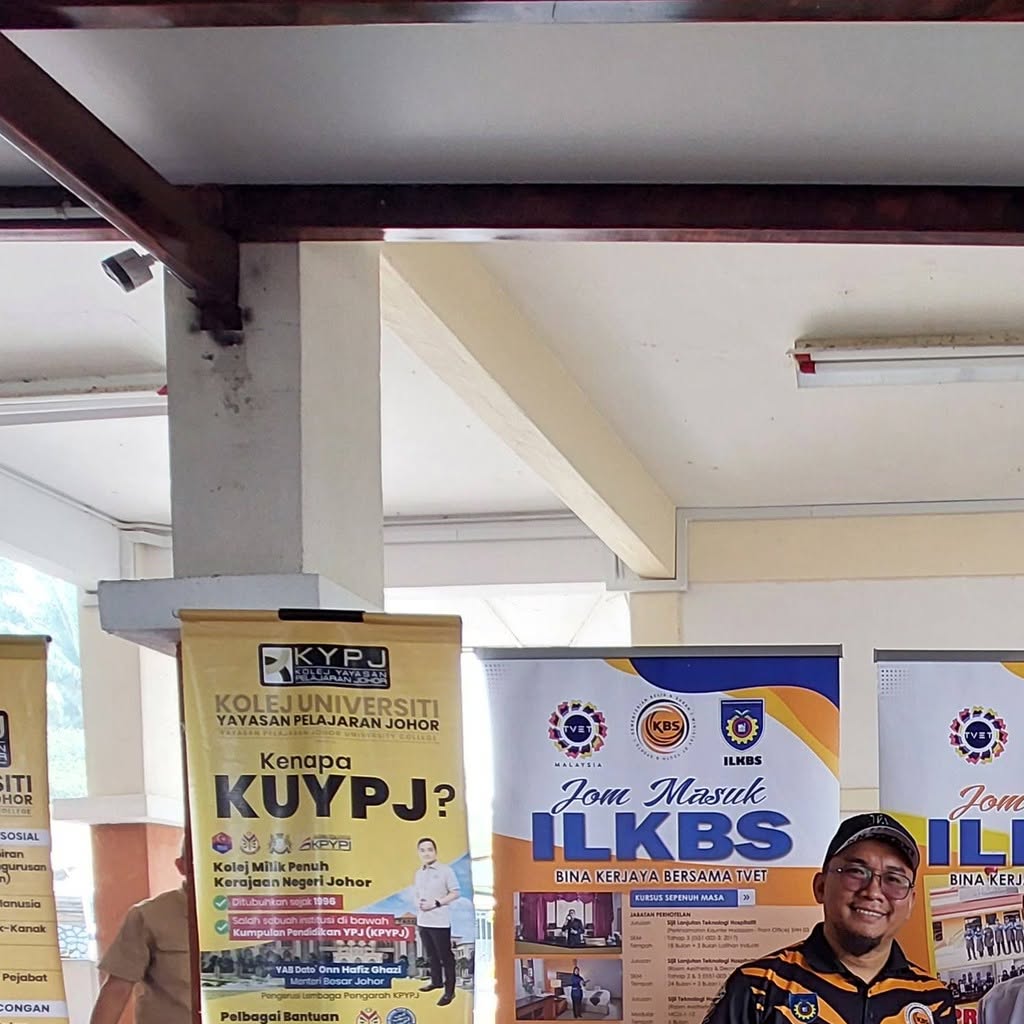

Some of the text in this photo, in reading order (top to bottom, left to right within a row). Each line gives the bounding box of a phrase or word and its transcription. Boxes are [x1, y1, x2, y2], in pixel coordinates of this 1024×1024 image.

[295, 647, 386, 668] KYPJ
[336, 670, 387, 678] YAYASAN
[216, 695, 439, 718] KOLEJ UNIVERSITI
[217, 715, 439, 731] YAYASAN PELAJARAN JOHOR
[563, 725, 592, 734] TVET
[653, 721, 680, 733] KBS
[964, 730, 993, 739] TVET
[261, 752, 351, 774] Kenapa
[724, 755, 762, 766] ILKBS
[551, 776, 768, 816] Jom Masuk
[1, 832, 39, 841] SOSIAL
[532, 810, 793, 862] ILKBS
[214, 861, 329, 875] Kolej Milik Penuh
[214, 875, 372, 889] Kerajaan Negeri Johor
[556, 869, 768, 884] BINA KERJAYA BERSAMA TVET
[950, 874, 985, 886] BINA
[233, 927, 410, 939] Kumpulan Pendidikan YPJ (KPYPJ)
[3, 973, 47, 984] Pejabat
[221, 1011, 339, 1024] Pelbagai Bantuan
